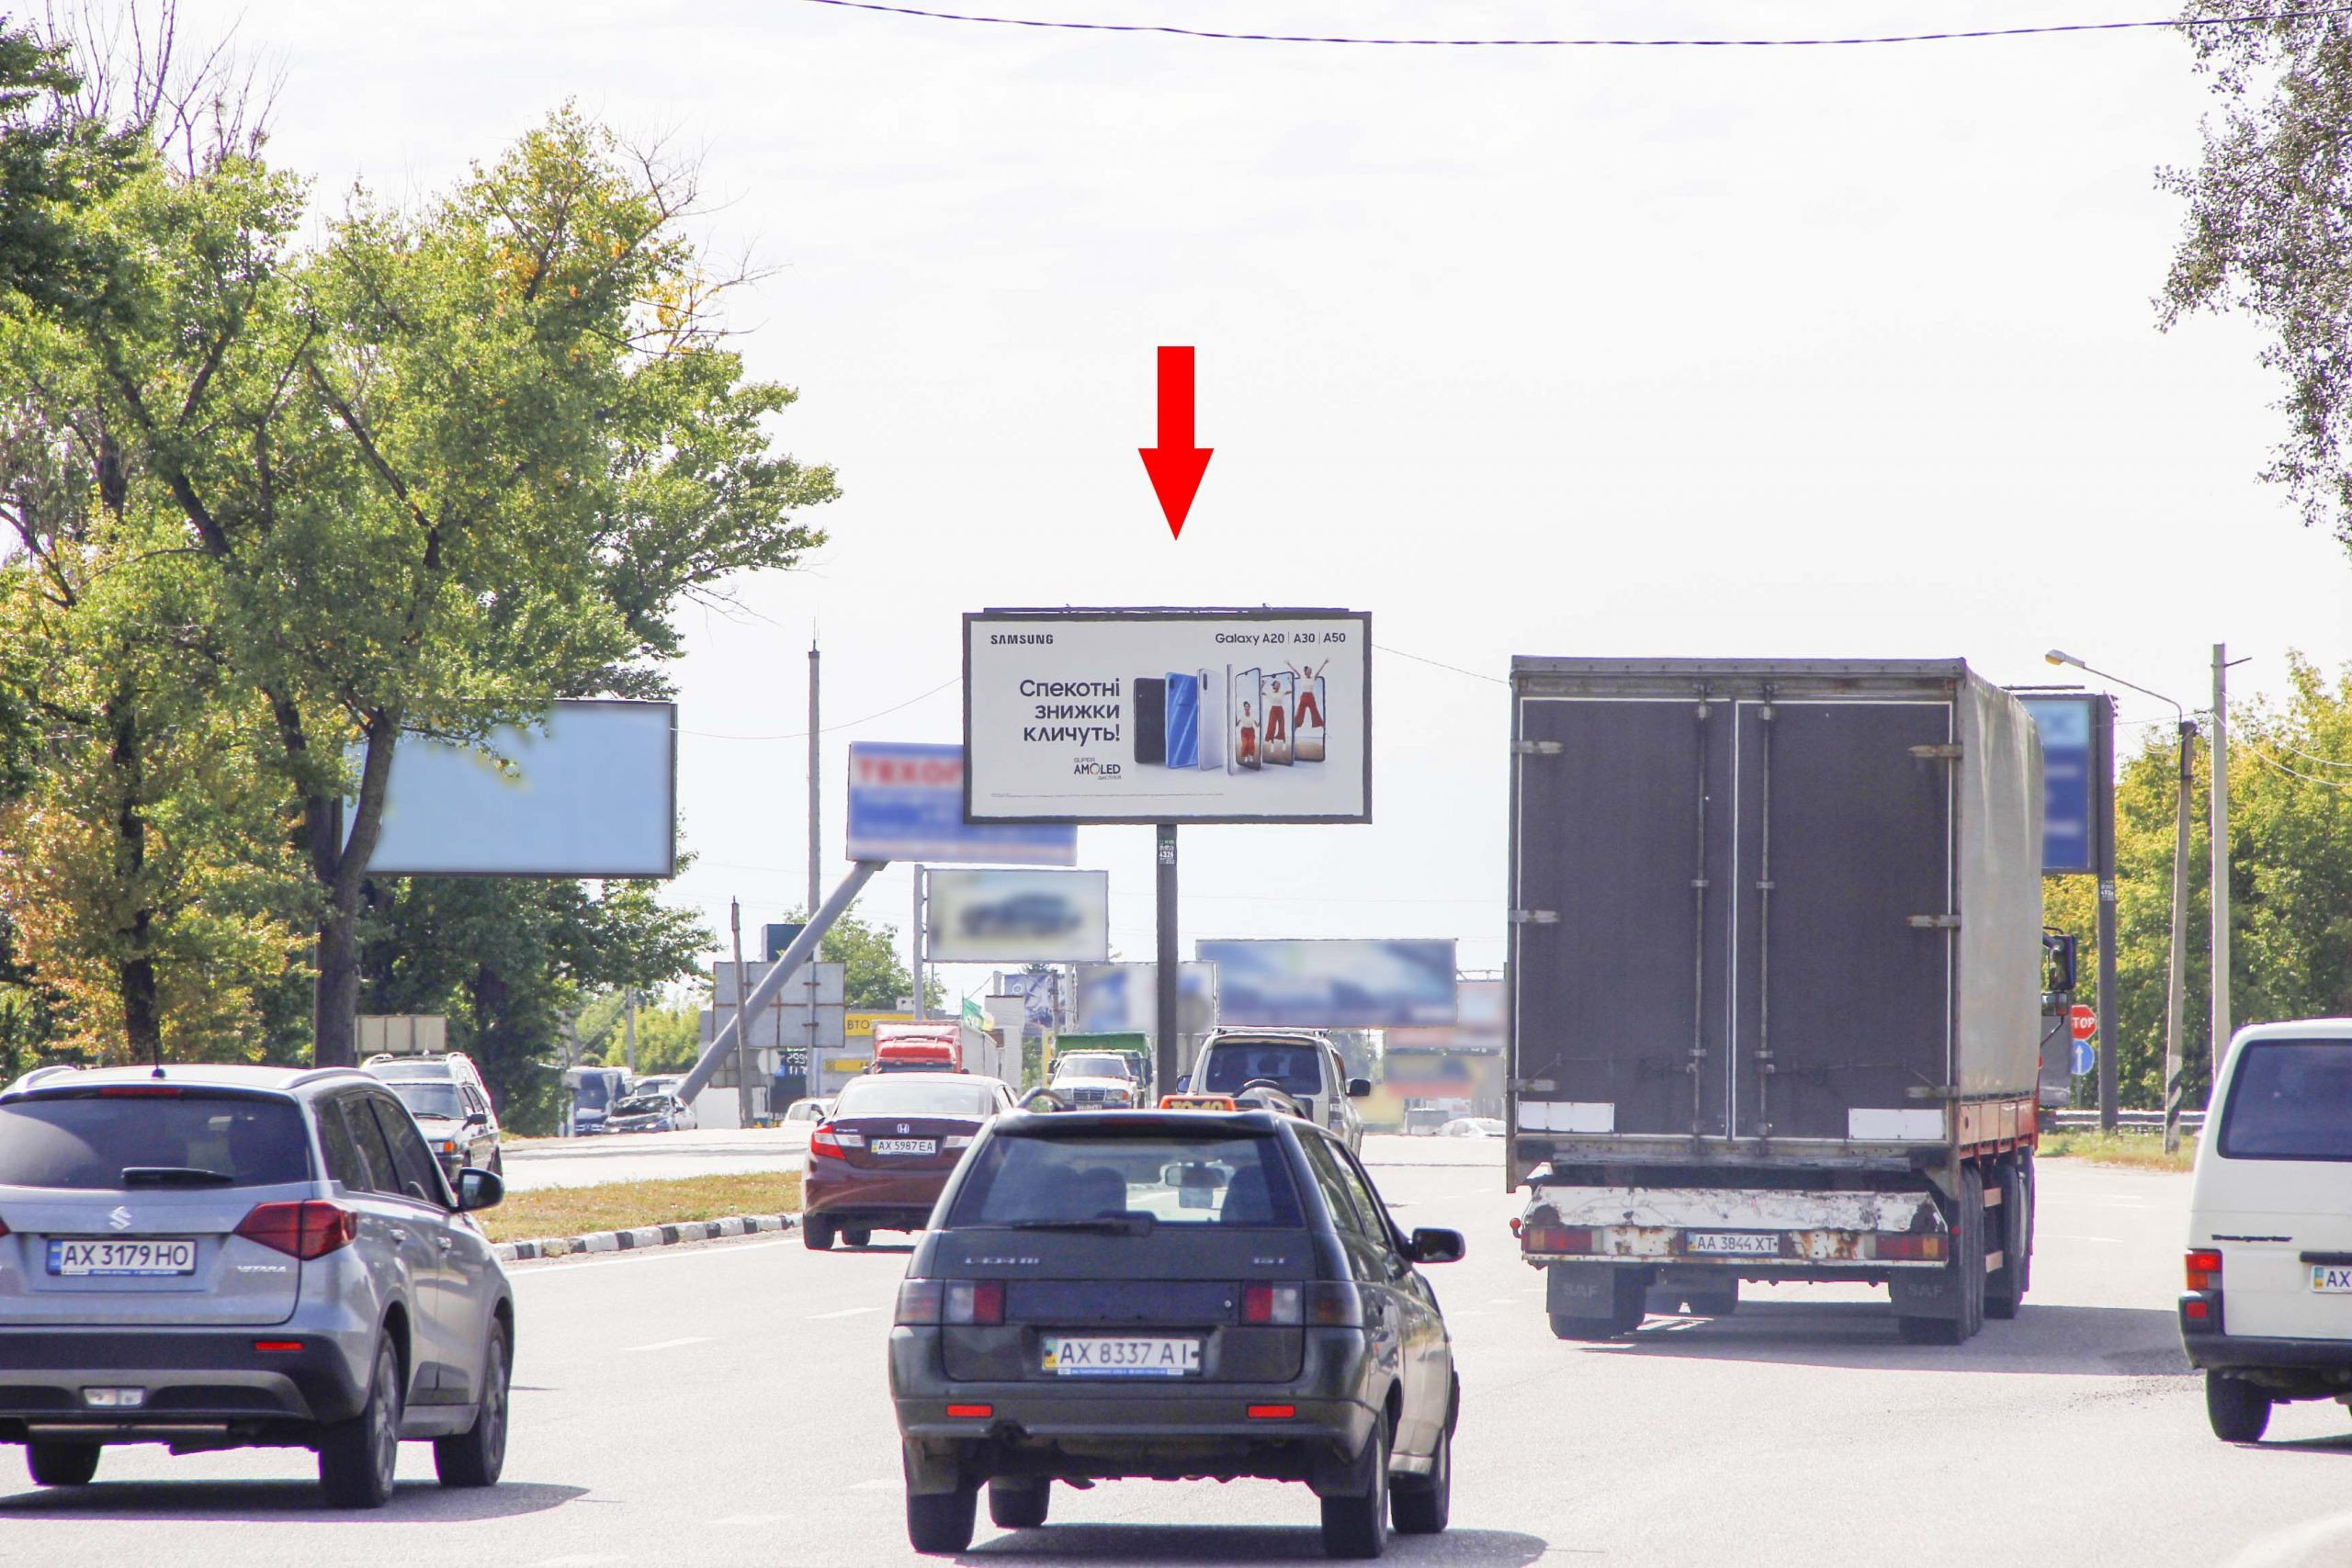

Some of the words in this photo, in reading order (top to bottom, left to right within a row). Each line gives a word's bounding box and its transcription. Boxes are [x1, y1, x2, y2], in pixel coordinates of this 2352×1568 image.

[990, 634, 1054, 645] SAMSUNG
[1215, 633, 1260, 646] Galaxy
[1262, 633, 1285, 644] A20
[1294, 633, 1316, 643] A30
[1323, 632, 1346, 643] A50
[1020, 678, 1120, 697] Спекотні
[1035, 705, 1120, 719] знижки
[1023, 723, 1120, 747] кличуть!
[1073, 762, 1121, 775] AMOLED
[2072, 1017, 2095, 1029] TOP
[878, 1141, 892, 1150] AX
[895, 1141, 918, 1150] 5987
[919, 1142, 933, 1151] EA
[1697, 1236, 1716, 1250] AA
[1720, 1236, 1752, 1250] 3844
[1755, 1237, 1774, 1251] XT
[63, 1245, 96, 1266] AX
[101, 1245, 152, 1267] 3179
[155, 1245, 188, 1266] HO
[2325, 1270, 2351, 1287] AX
[1059, 1343, 1091, 1364] AX
[1099, 1343, 1152, 1365] 8337
[1159, 1343, 1187, 1364] AI
